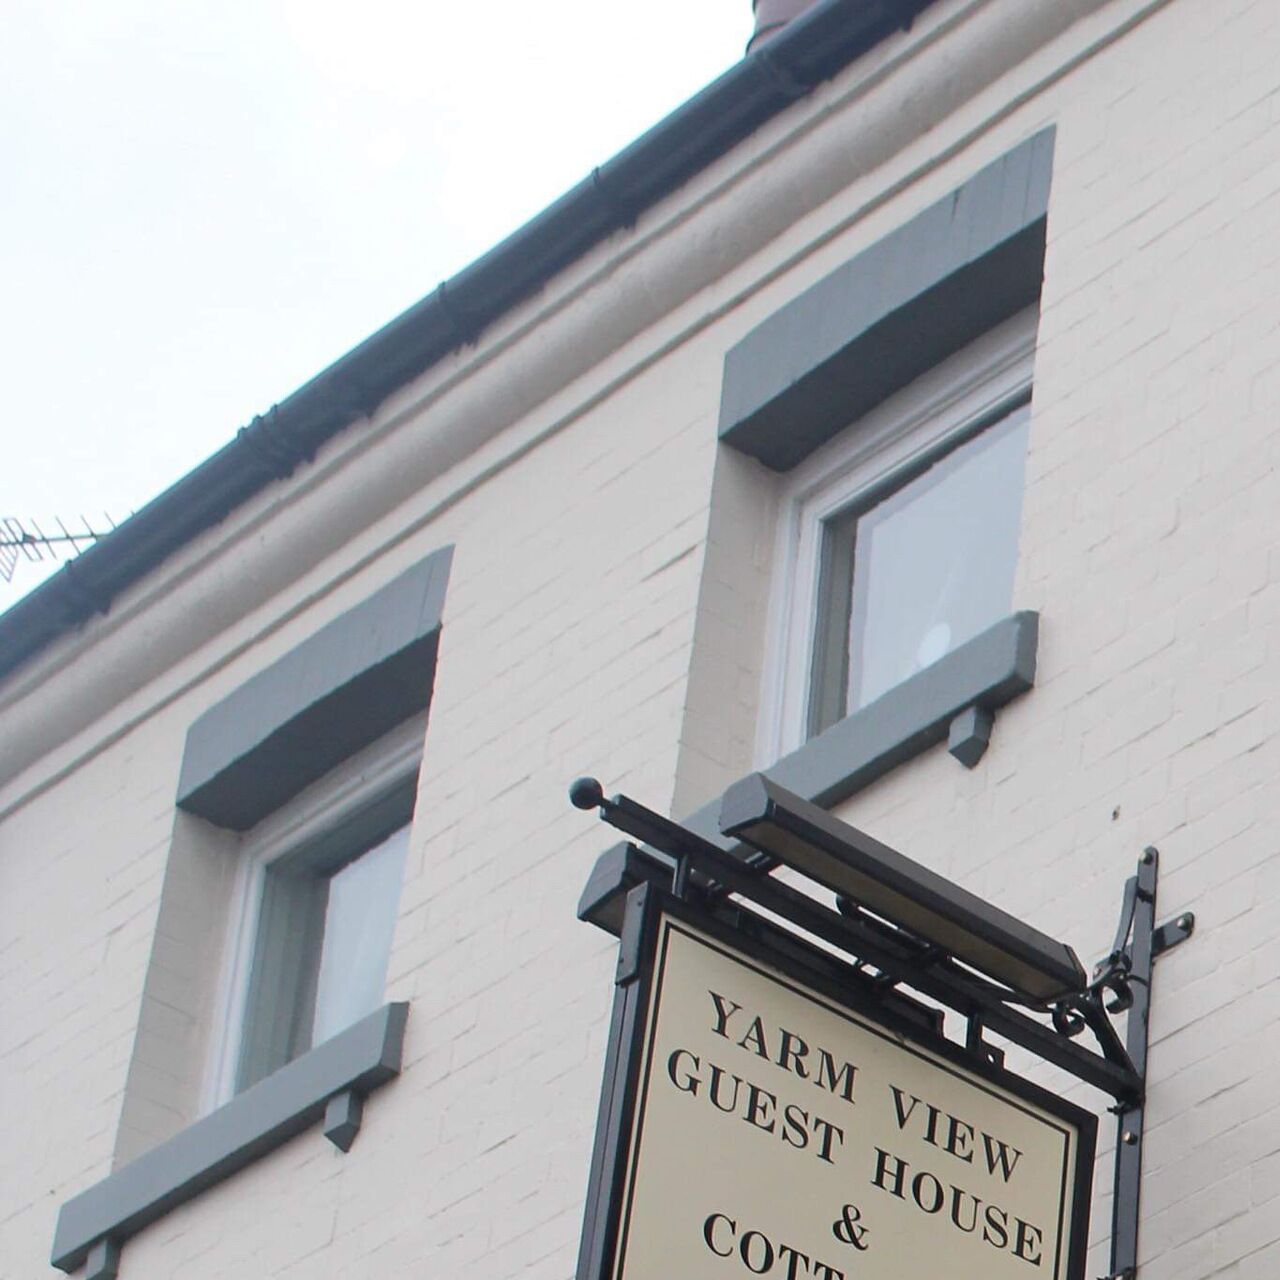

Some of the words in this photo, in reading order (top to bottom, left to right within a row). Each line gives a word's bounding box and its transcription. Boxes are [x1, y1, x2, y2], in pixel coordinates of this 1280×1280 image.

[667, 1048, 844, 1165] GUEST
[871, 1147, 1043, 1267] HOUSE
[709, 990, 859, 1104] YARM
[888, 1085, 1023, 1184] VIEW
[832, 1204, 869, 1251] &
